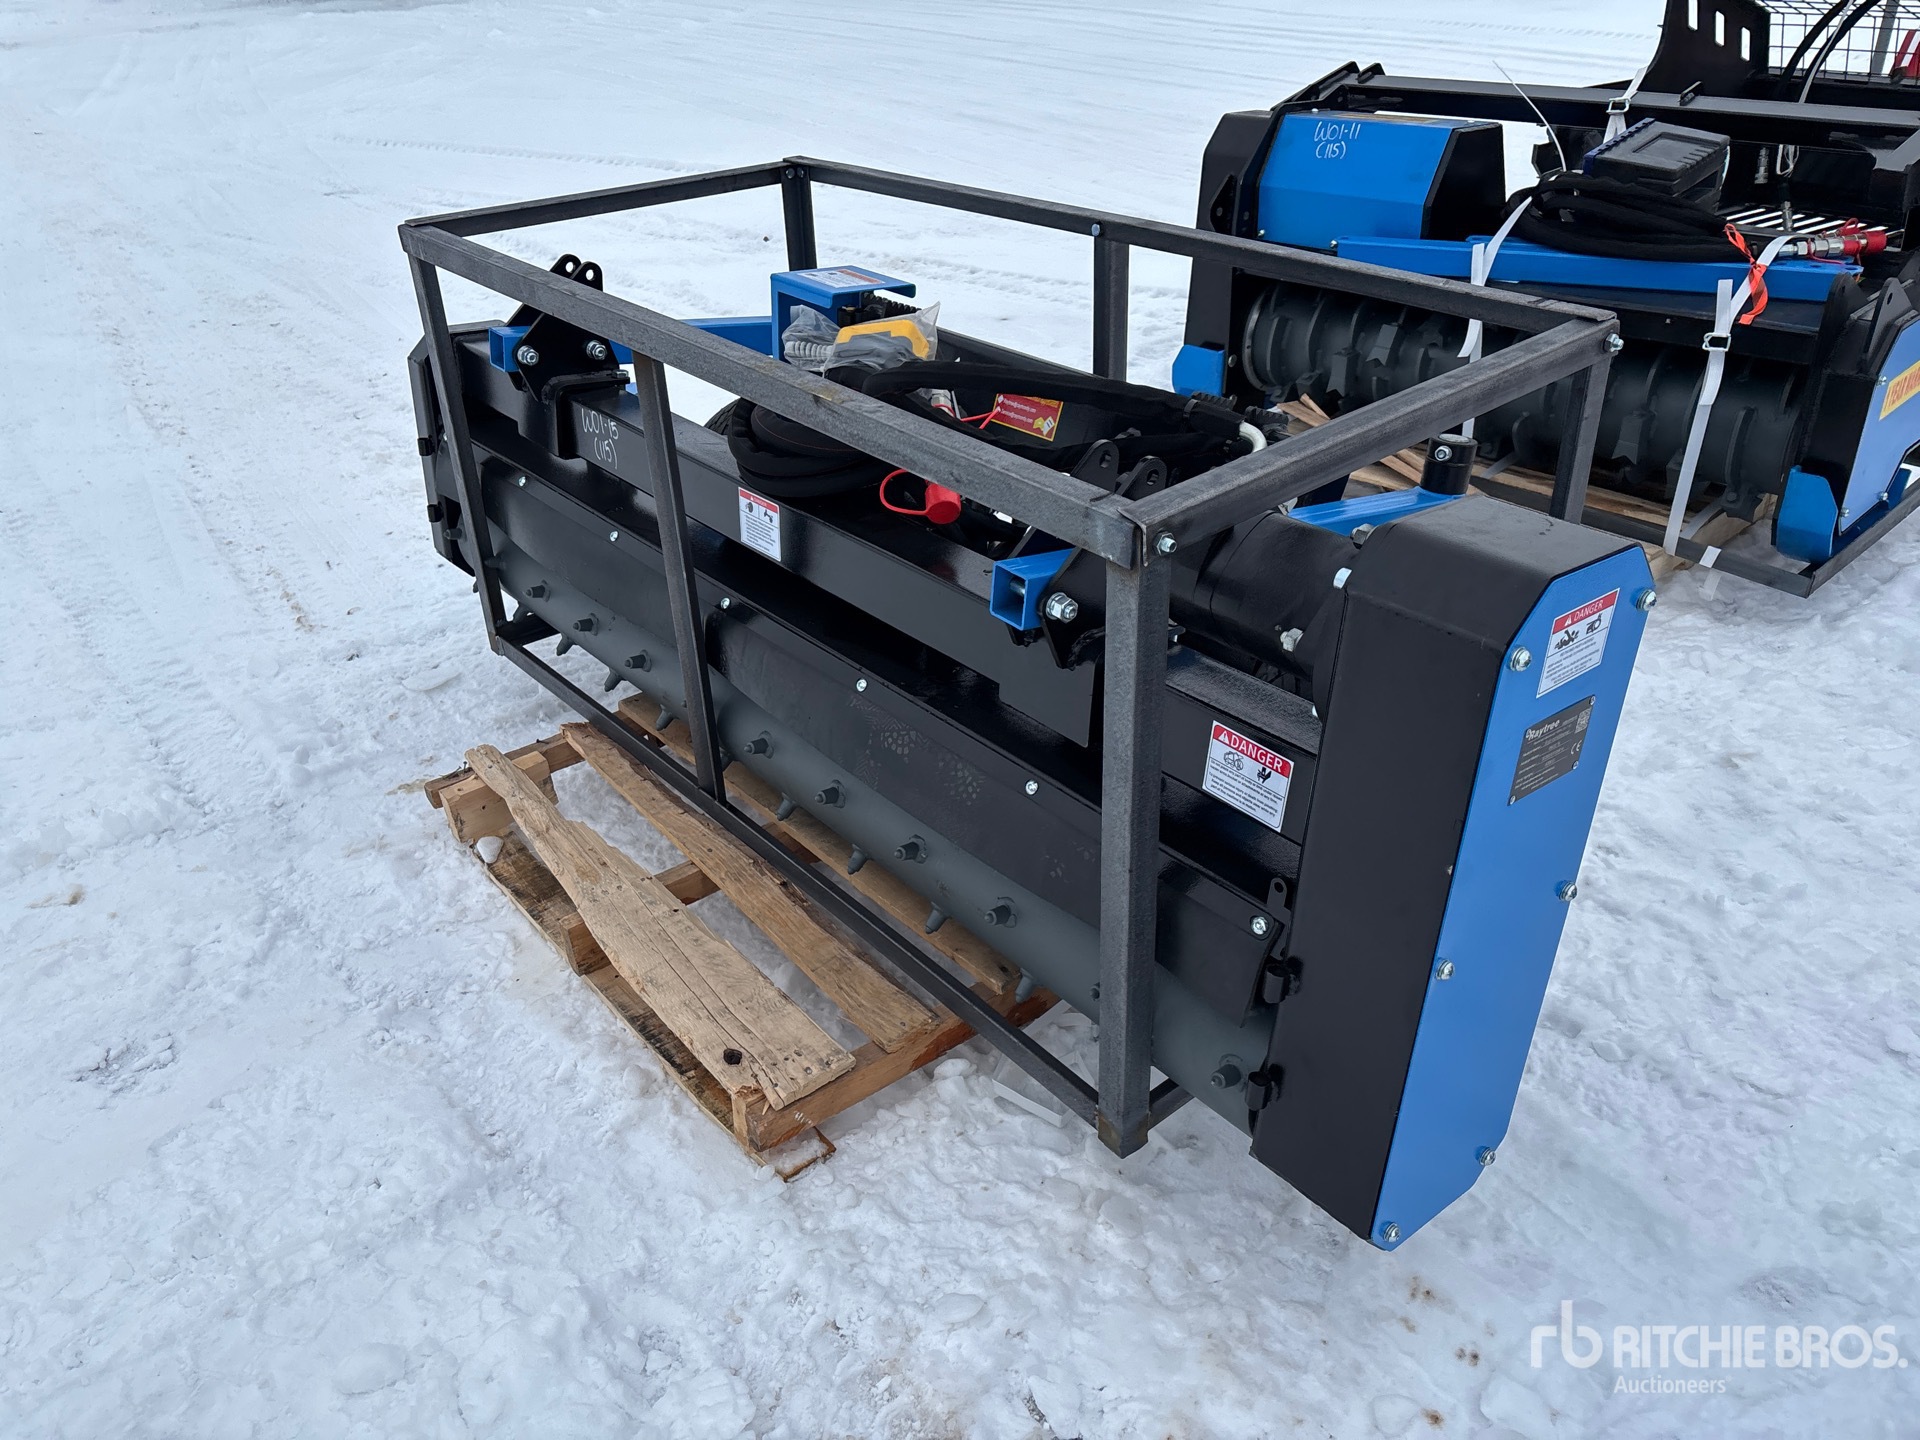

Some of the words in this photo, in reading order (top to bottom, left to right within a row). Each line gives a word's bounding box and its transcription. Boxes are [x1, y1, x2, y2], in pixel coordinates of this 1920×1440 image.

[1315, 141, 1347, 160] (115)
[594, 436, 618, 470] (115)
[1573, 600, 1604, 622] DANGER
[1528, 719, 1560, 741] Raytree
[1230, 734, 1283, 773] DANGER
